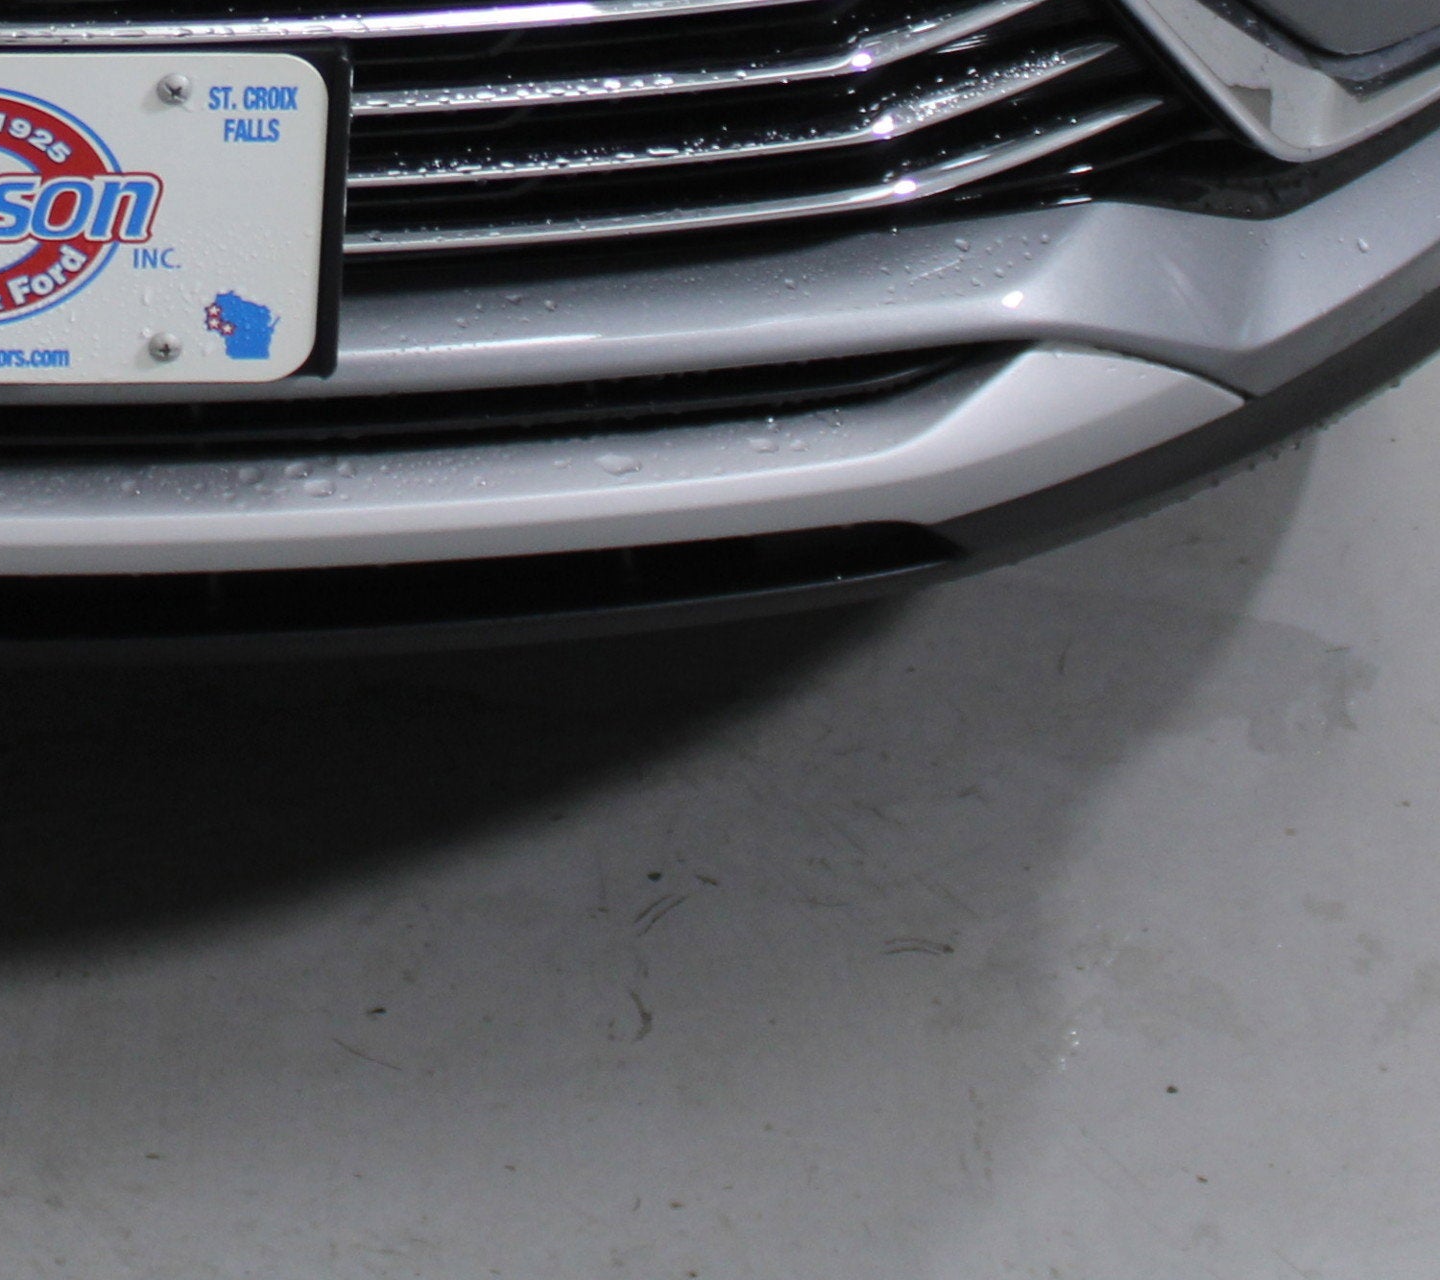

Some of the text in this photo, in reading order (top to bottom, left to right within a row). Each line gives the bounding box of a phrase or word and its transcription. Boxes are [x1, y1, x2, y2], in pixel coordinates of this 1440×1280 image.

[208, 85, 299, 110] ST. CROIX
[224, 118, 280, 143] FALLS
[133, 247, 182, 270] INC.
[6, 244, 89, 307] Ford
